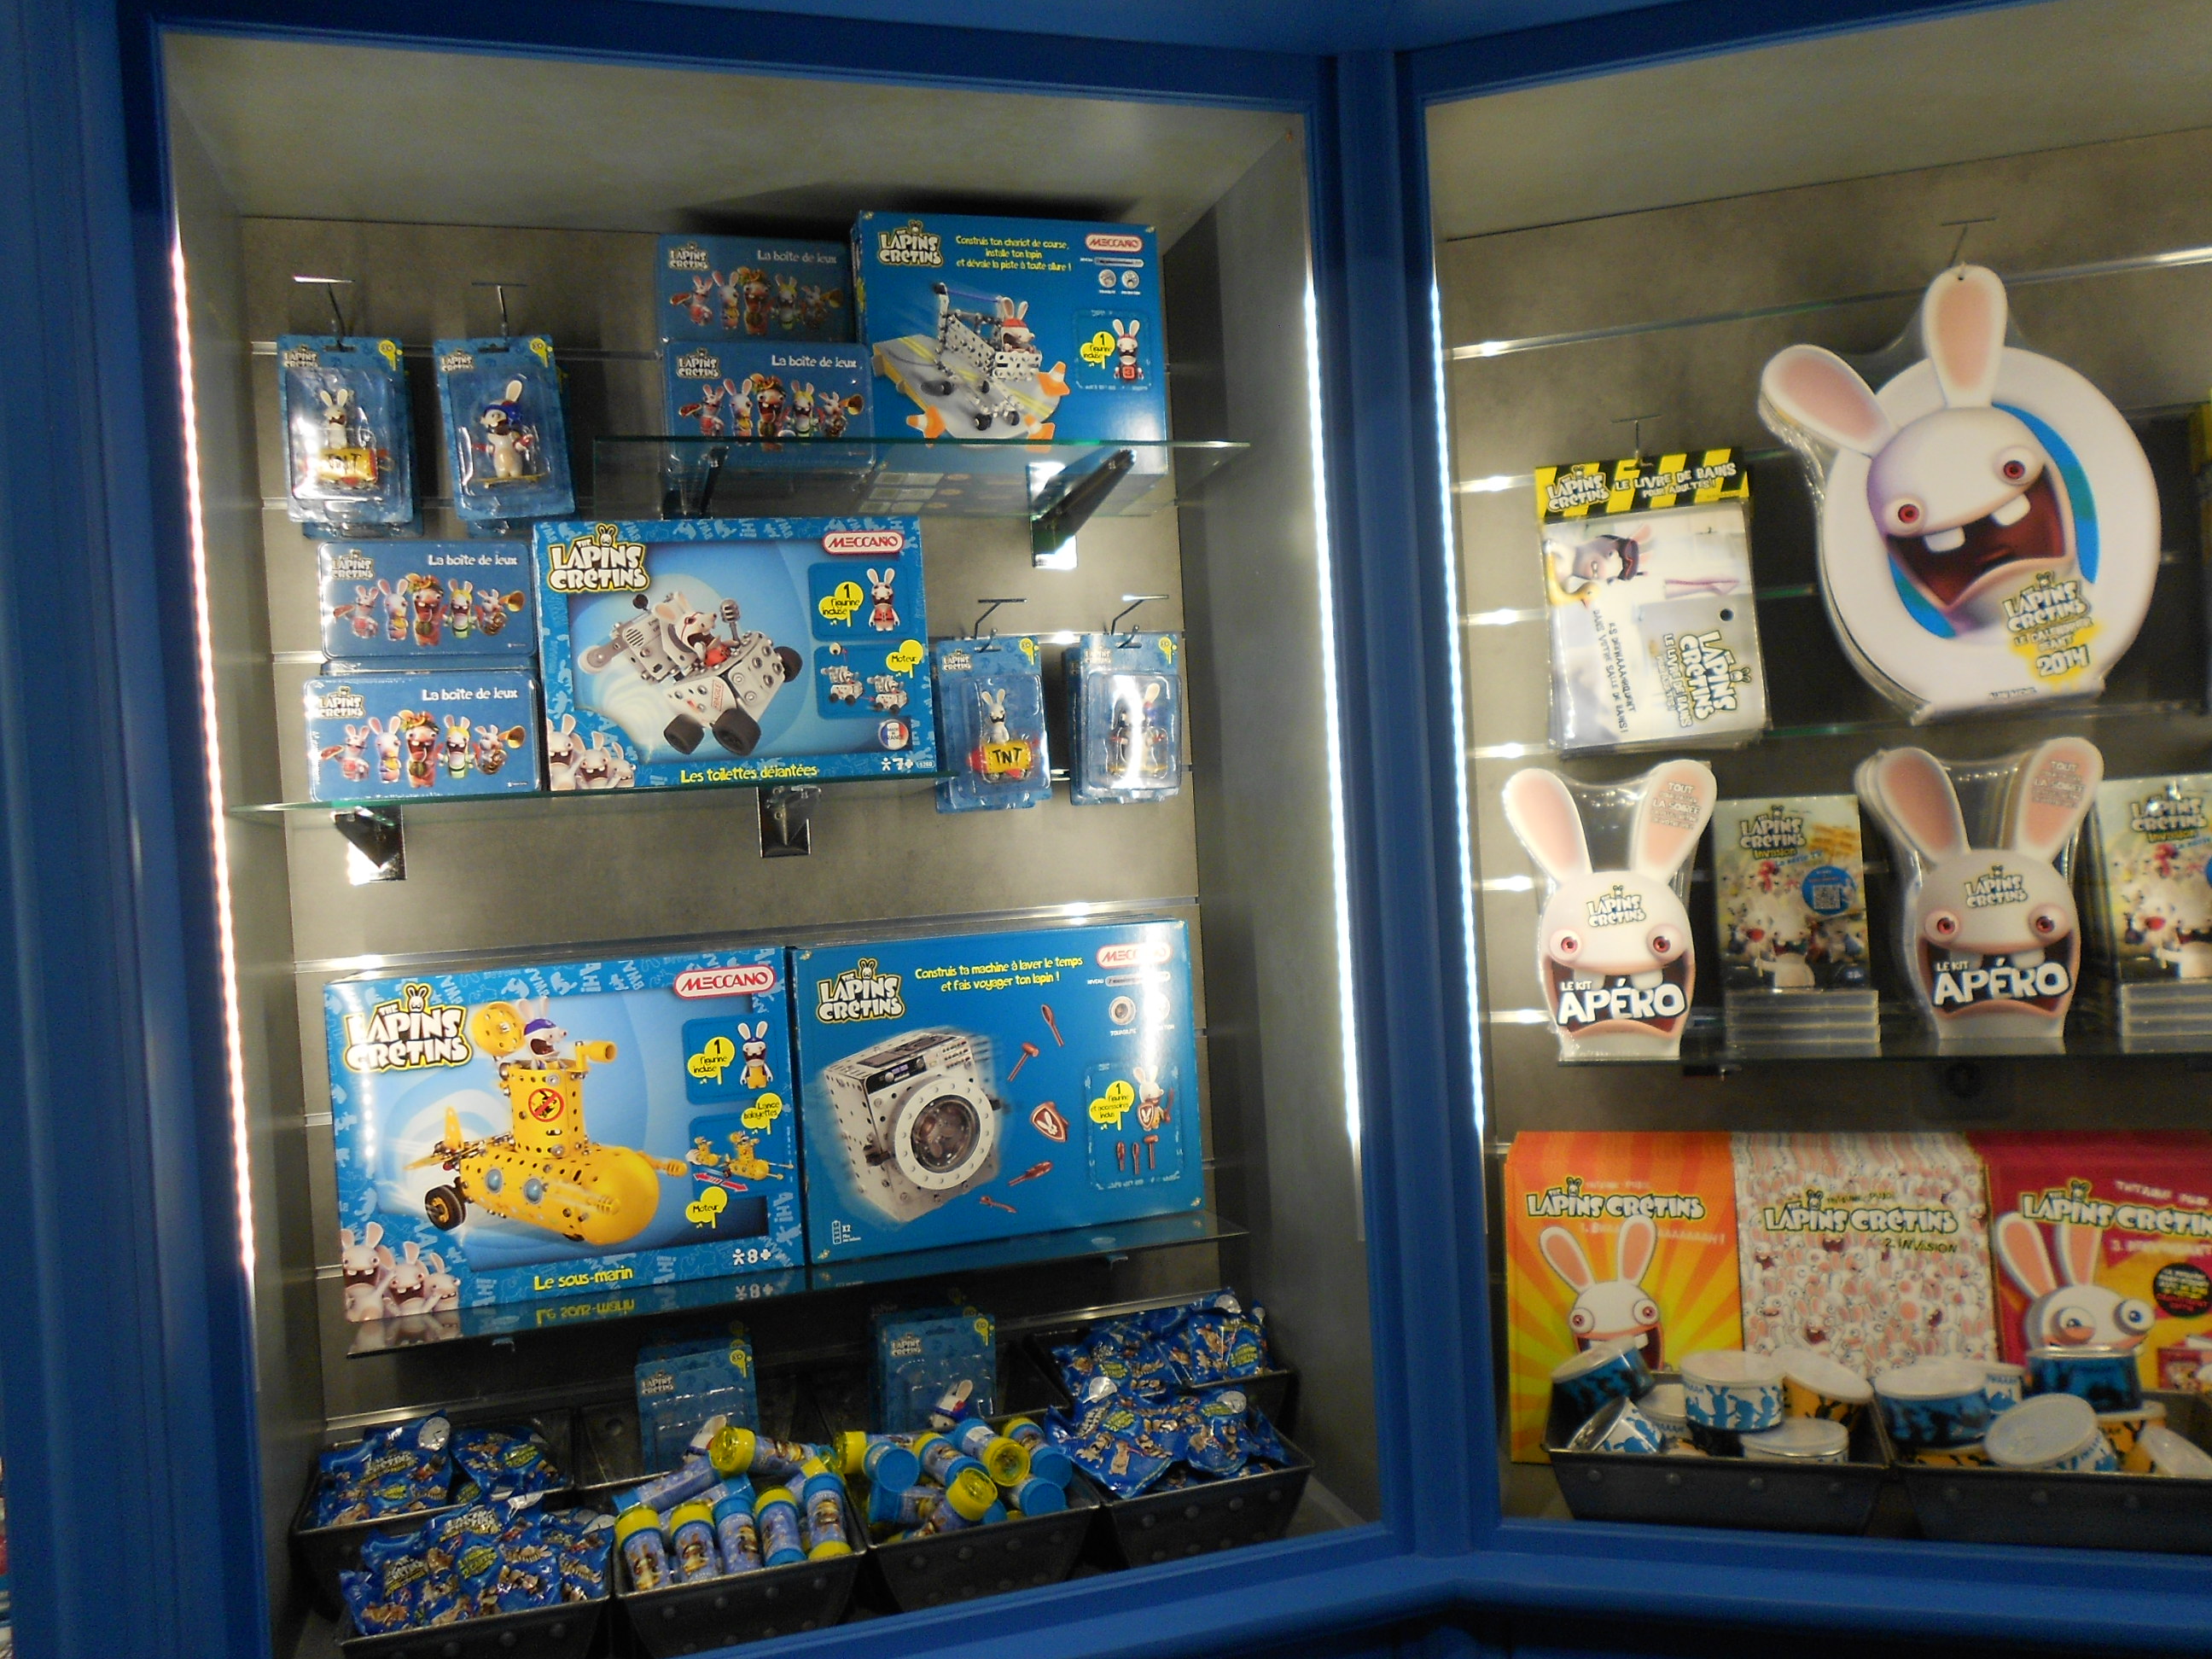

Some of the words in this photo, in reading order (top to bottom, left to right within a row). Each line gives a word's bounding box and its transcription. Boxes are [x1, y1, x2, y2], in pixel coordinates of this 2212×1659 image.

[880, 234, 938, 252] LAPINS
[956, 236, 988, 246] Construis
[990, 237, 1003, 246] ton
[1032, 238, 1042, 247] de
[1089, 236, 1139, 248] MECCANO
[758, 250, 771, 261] La
[801, 251, 815, 262] de
[1100, 334, 1105, 346] 1
[679, 358, 717, 369] LAPINS
[771, 354, 785, 366] La
[819, 357, 833, 368] de
[1546, 473, 1604, 498] LAPINS
[1615, 480, 1630, 492] LE
[1634, 474, 1672, 490] LIVRE
[1675, 469, 1692, 483] DE
[829, 534, 899, 549] MECCANO
[428, 555, 444, 566] La
[478, 555, 492, 565] de
[550, 544, 642, 569] LAPINS
[843, 584, 851, 598] 1
[2003, 580, 2079, 618] LAPINS
[1663, 633, 1674, 646] LE
[891, 655, 918, 663] Moteur
[2036, 644, 2090, 677] 2014
[1697, 631, 1738, 711] LAPINS
[422, 689, 439, 701] La
[475, 688, 492, 700] de
[992, 747, 1023, 767] TNT
[680, 769, 704, 783] Les
[707, 765, 758, 781] toilettes
[1668, 782, 1694, 795] TOUT
[1740, 818, 1803, 835] LAPINS
[1965, 876, 2022, 896] LAPINS
[1586, 894, 1641, 916] LAPINS
[915, 965, 958, 980] Construis
[959, 965, 970, 976] ta
[971, 962, 1010, 975] machine
[1011, 960, 1018, 971] à
[1020, 958, 1043, 971] laver
[1045, 957, 1053, 968] le
[1055, 956, 1084, 969] temps
[1936, 963, 1950, 971] LE
[1951, 960, 1969, 971] KIT
[681, 971, 768, 992] MECCANO
[819, 975, 899, 1003] LAPINS
[940, 981, 952, 992] et
[953, 980, 971, 991] fais
[973, 977, 1014, 991] voyager
[1016, 975, 1032, 986] ton
[1033, 973, 1055, 987] lapin
[1561, 981, 1575, 992] LE
[1575, 981, 1592, 991] KIT
[1934, 958, 2071, 1007] APÉRO
[1557, 977, 1686, 1025] APÉRO
[346, 1008, 463, 1045] LAPINS
[713, 1039, 721, 1054] 1
[1115, 1082, 1121, 1095] 1
[757, 1101, 780, 1110] Lance
[692, 1202, 719, 1213] Moteur
[1527, 1195, 1604, 1219] LAPINS
[2023, 1194, 2115, 1227] LAPINS
[1764, 1208, 1848, 1232] LAPINS
[1899, 1240, 1958, 1254] INVASION
[533, 1275, 554, 1291] Le
[558, 1265, 633, 1289] sous-marin
